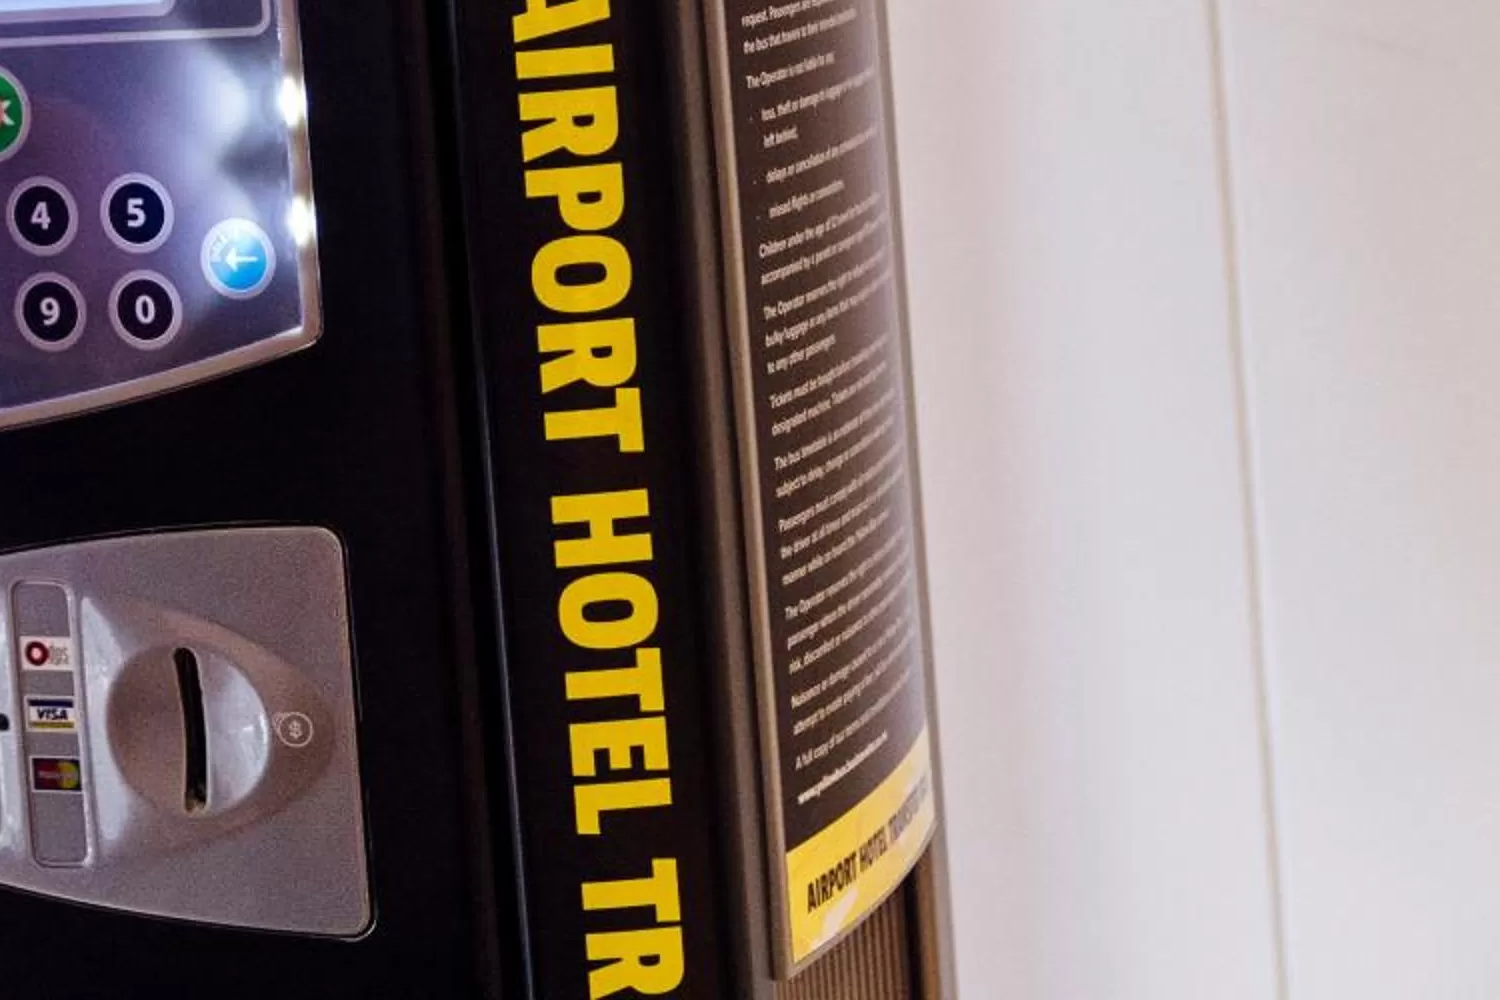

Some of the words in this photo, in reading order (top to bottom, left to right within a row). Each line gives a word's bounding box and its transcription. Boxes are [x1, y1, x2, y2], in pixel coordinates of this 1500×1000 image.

[30, 200, 52, 232] 4
[126, 197, 147, 229] 5
[39, 296, 59, 327] 9
[135, 294, 155, 325] 0
[550, 488, 672, 835] HOTEL
[36, 707, 69, 722] VISA
[807, 851, 857, 914] AIRPORT
